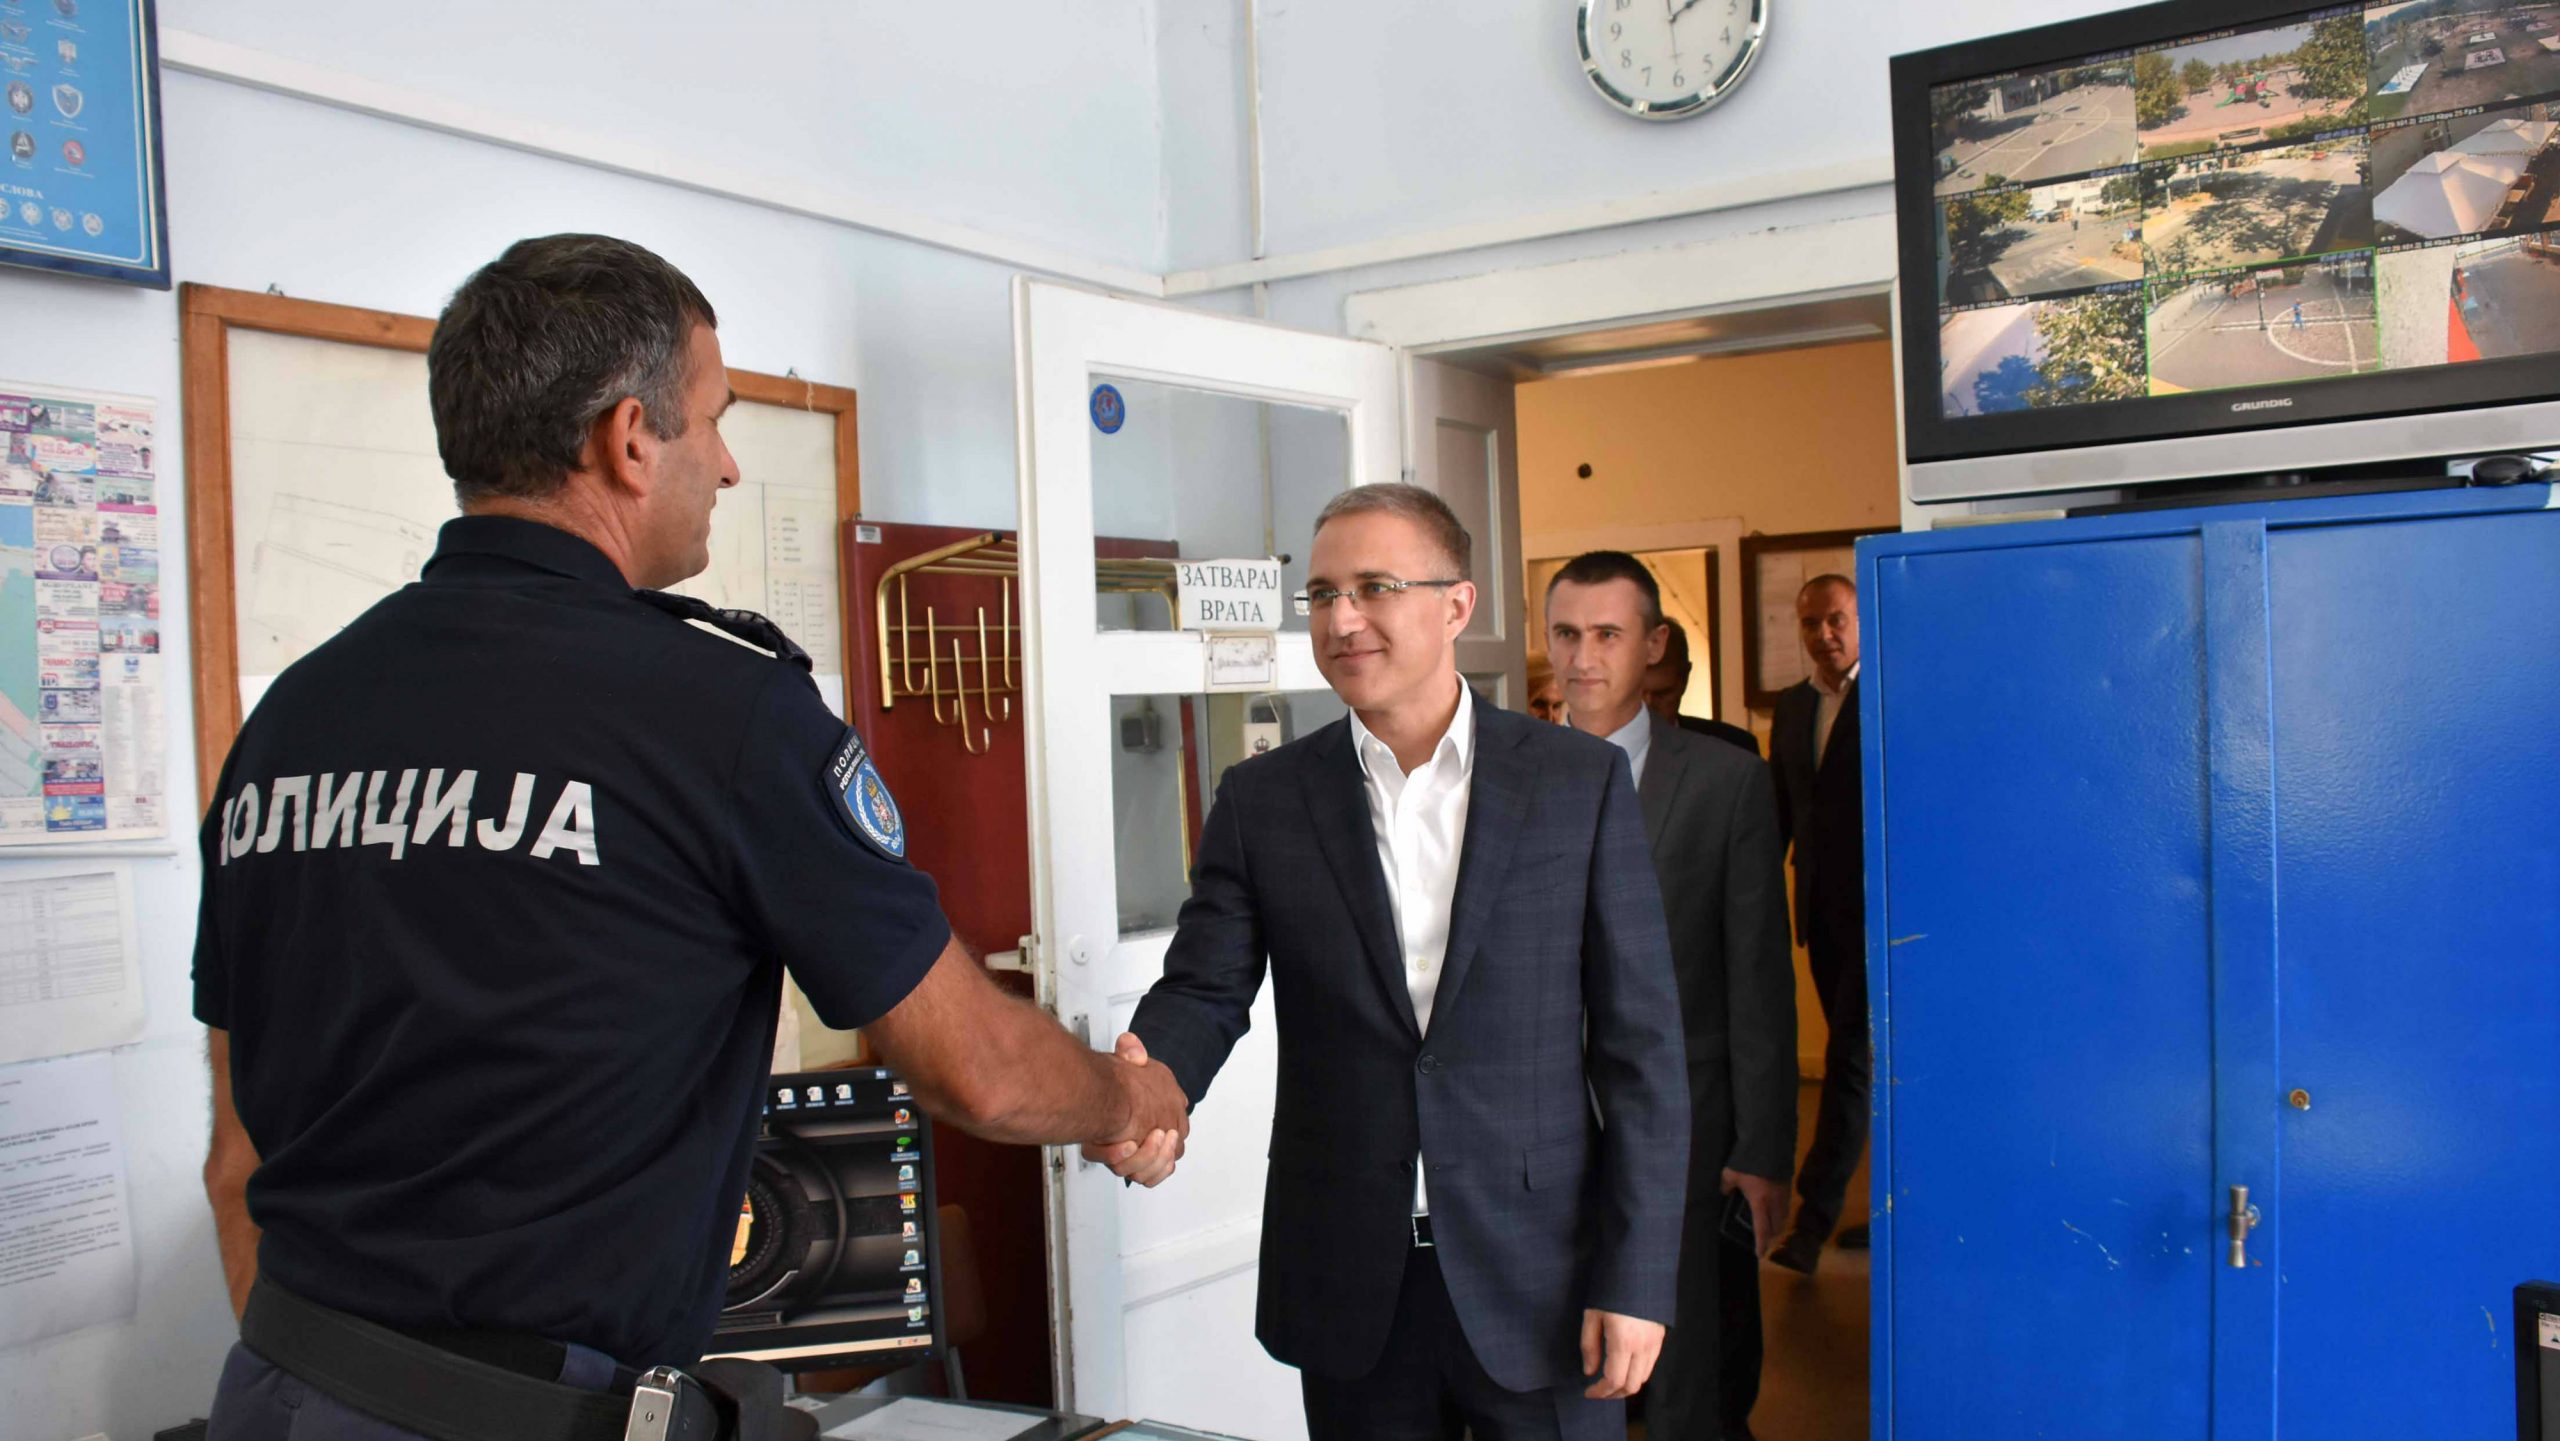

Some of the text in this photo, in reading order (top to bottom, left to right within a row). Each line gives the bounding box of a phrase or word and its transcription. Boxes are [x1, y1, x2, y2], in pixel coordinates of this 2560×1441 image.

[1611, 23, 1622, 41] 9
[1719, 26, 1731, 45] 4
[1621, 49, 1632, 69] 8
[1703, 54, 1713, 74] 5
[1641, 66, 1652, 87] 7
[1672, 68, 1684, 88] 6
[0, 183, 44, 200] СЛОВА
[2230, 397, 2294, 412] GRUNDIG
[1181, 564, 1279, 590] ЗАТВАРАЈ
[1200, 599, 1264, 622] ВРАТА
